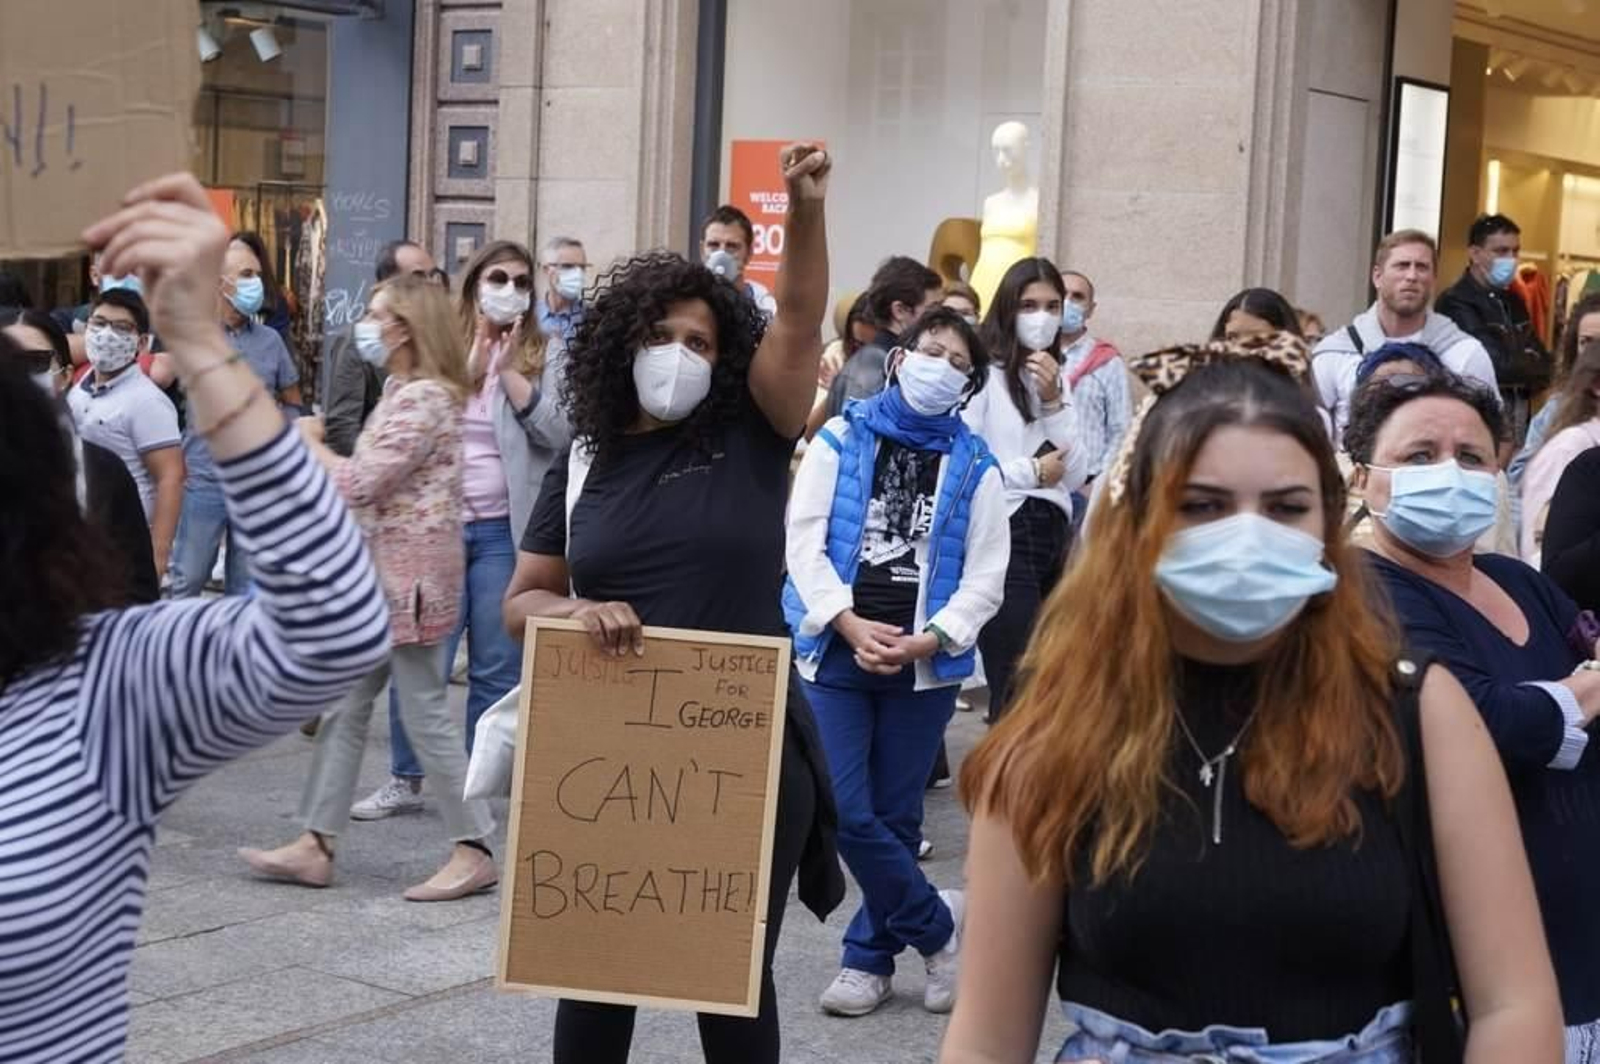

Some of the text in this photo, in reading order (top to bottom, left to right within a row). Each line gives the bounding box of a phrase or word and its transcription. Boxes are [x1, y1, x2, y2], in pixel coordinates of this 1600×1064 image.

[749, 192, 789, 203] WELCO
[690, 647, 776, 675] JUSTICE
[624, 666, 684, 729] I
[678, 700, 768, 729] GEORGE
[556, 756, 744, 825] CAN'T
[525, 850, 755, 919] BREATHE!
